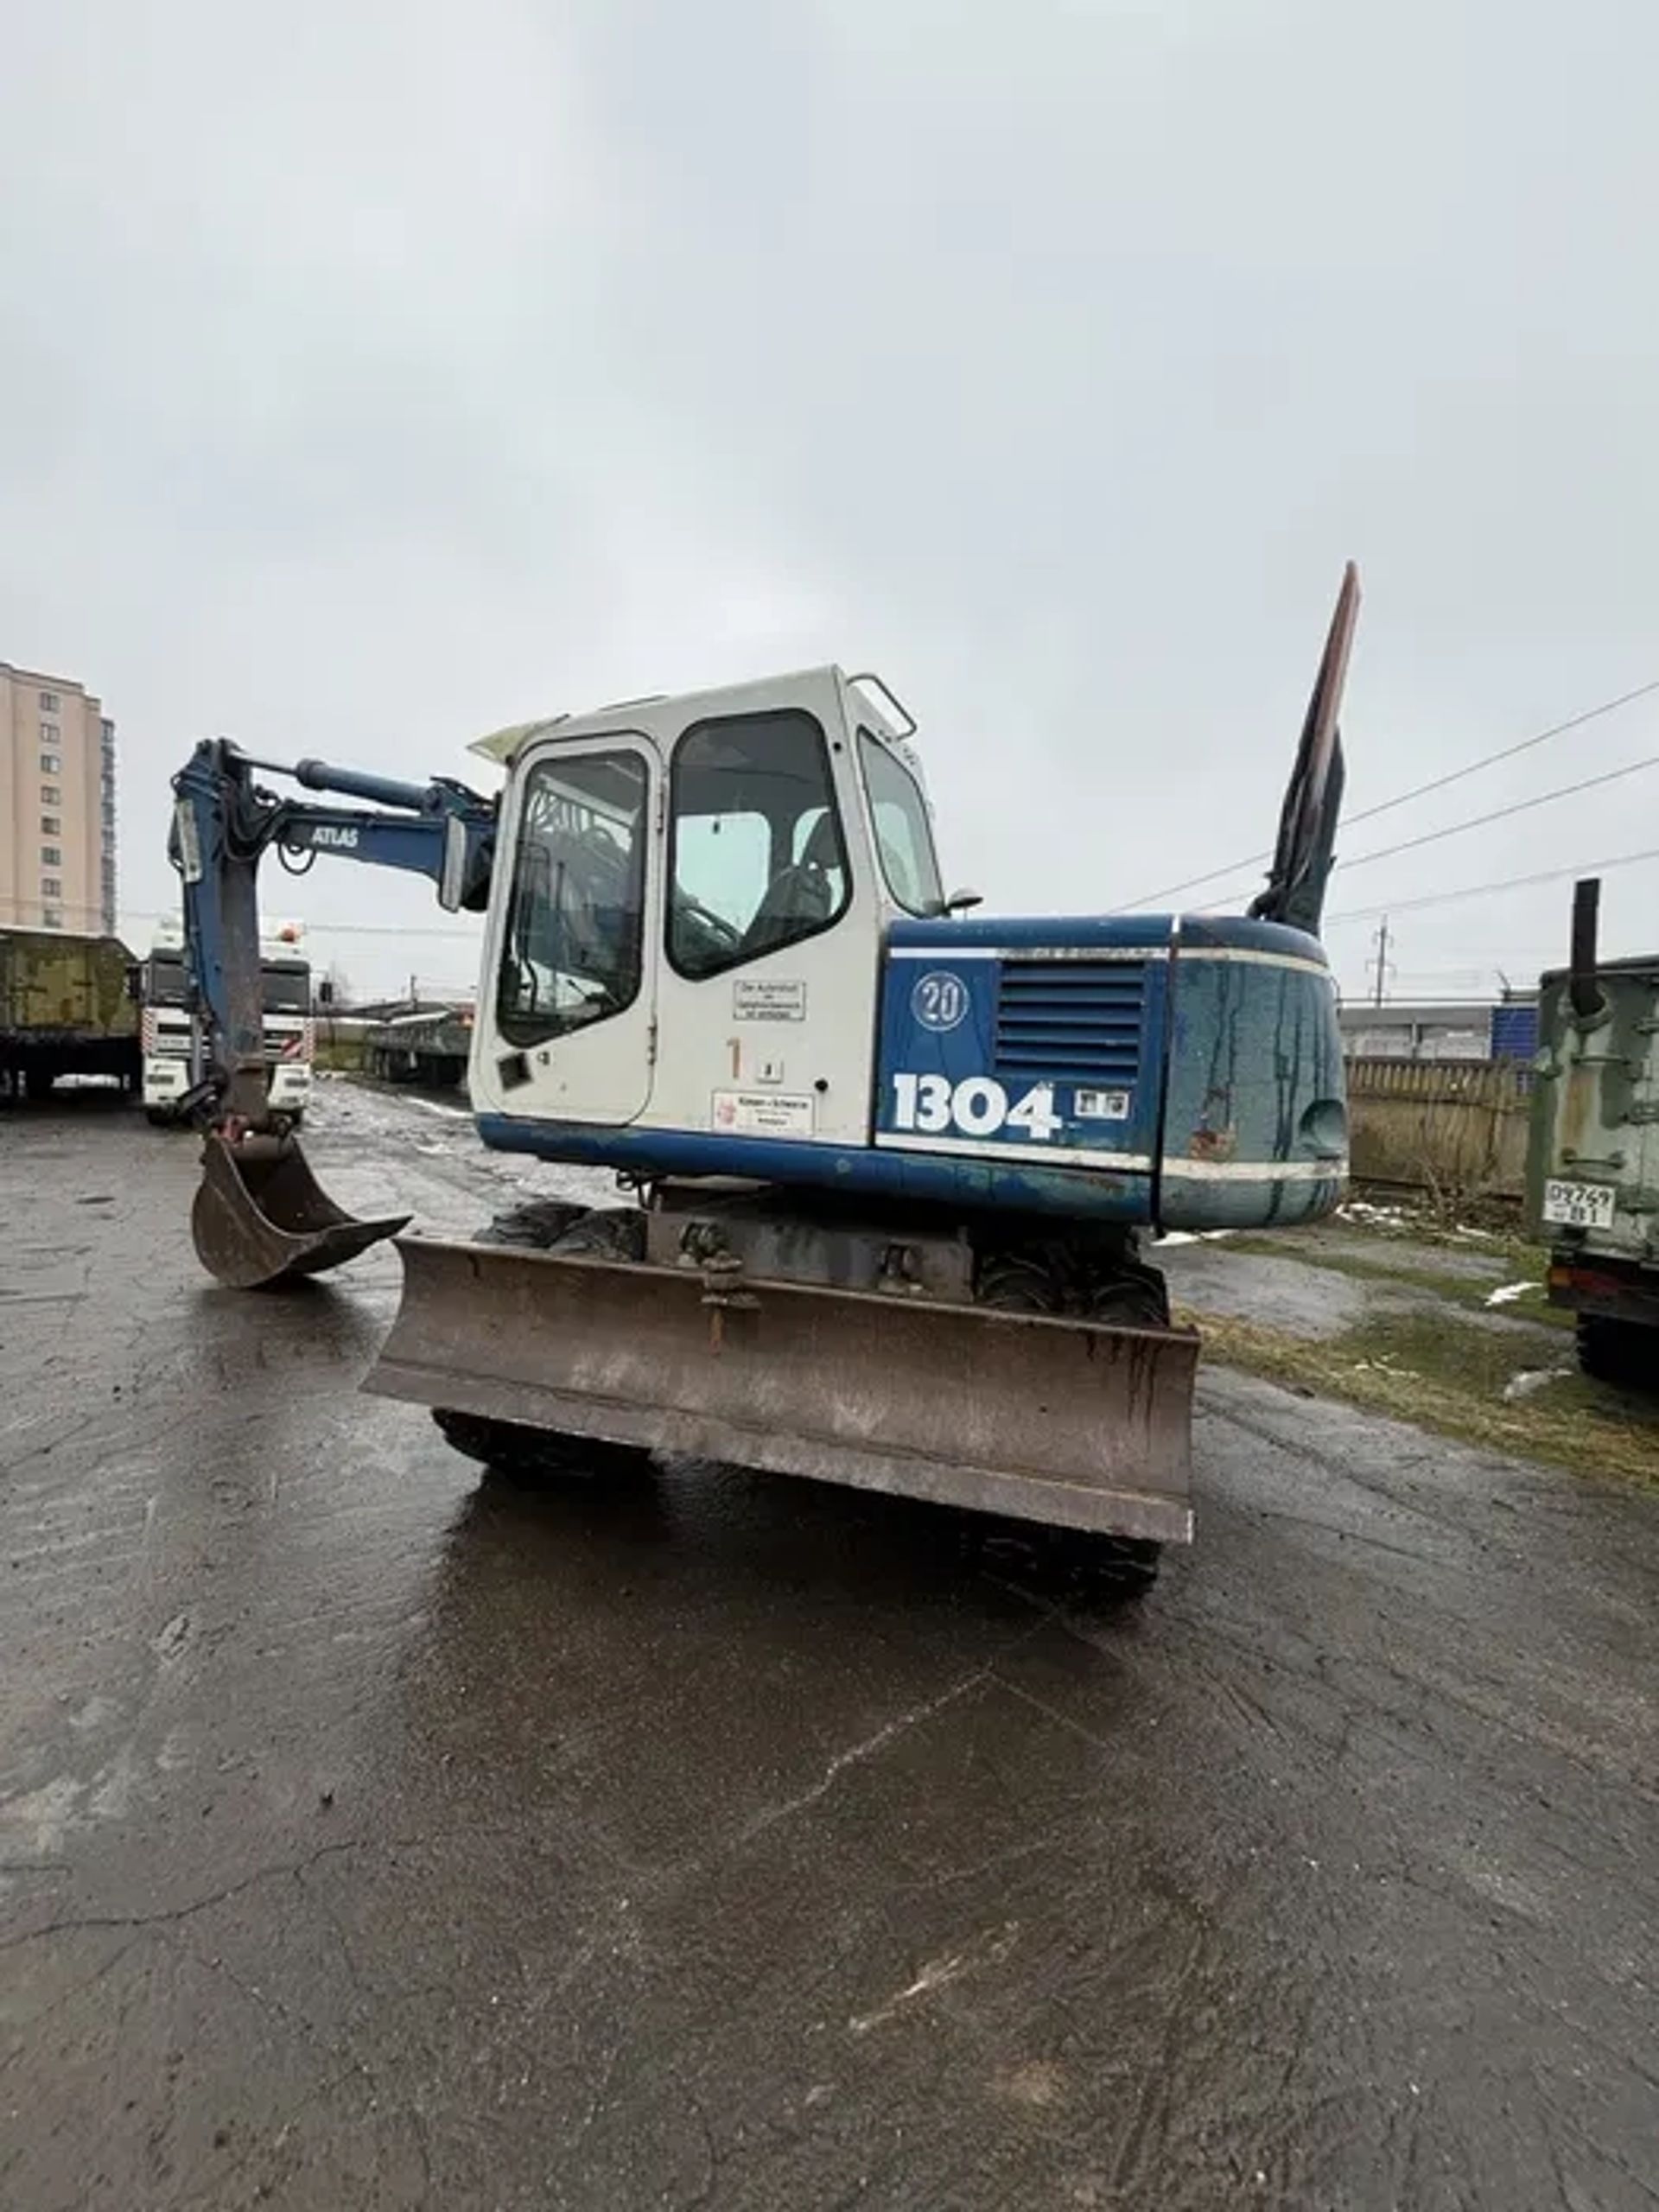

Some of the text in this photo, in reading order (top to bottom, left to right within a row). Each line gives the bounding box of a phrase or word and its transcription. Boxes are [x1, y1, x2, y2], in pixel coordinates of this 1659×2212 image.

[312, 826, 359, 848] ATLAS
[922, 982, 958, 1021] 20
[893, 1073, 1063, 1139] 1304
